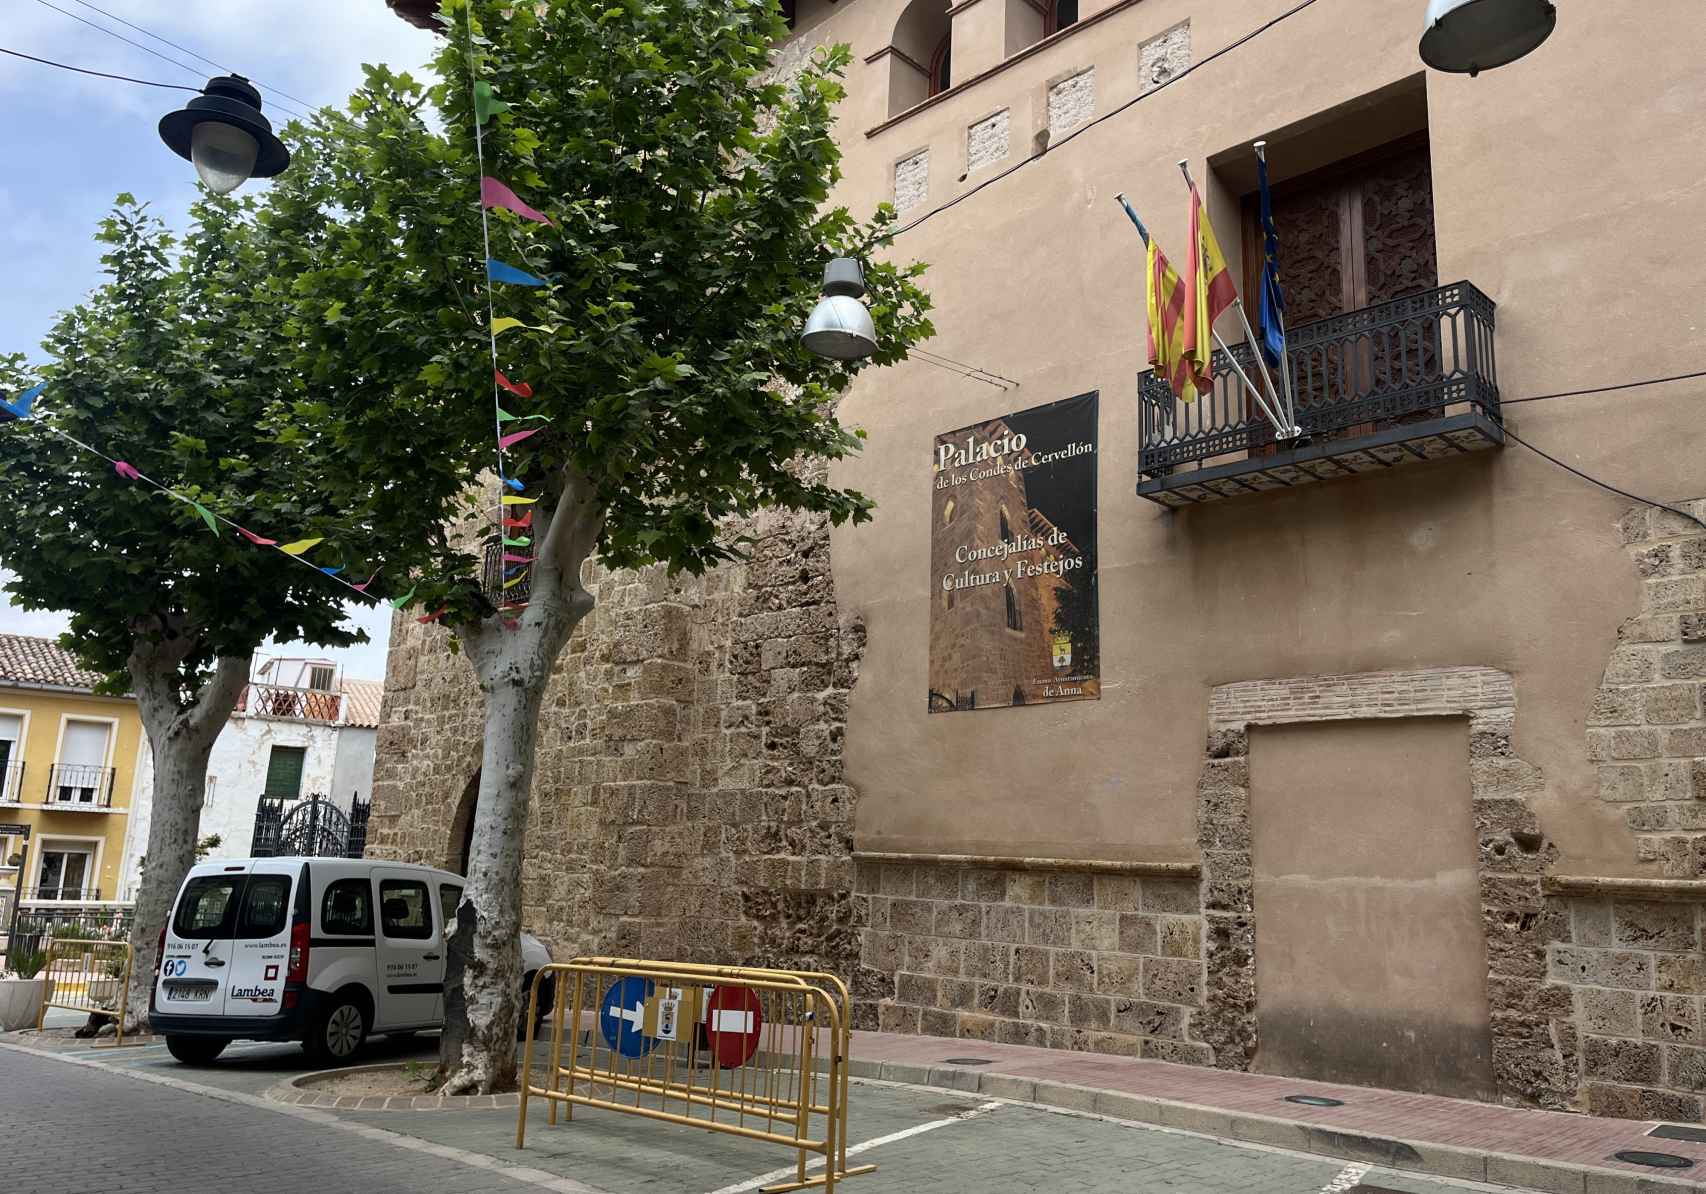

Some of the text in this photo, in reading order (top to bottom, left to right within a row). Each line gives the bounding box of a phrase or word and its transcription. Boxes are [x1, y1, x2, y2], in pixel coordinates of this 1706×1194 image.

[936, 441, 1093, 490] de los Condes de Cervellón
[937, 429, 1027, 472] Palacio
[955, 526, 1068, 564] Concejalías de
[942, 554, 1084, 592] Cultura y Festejos
[1042, 684, 1083, 697] de Anna
[231, 985, 275, 998] Lambea
